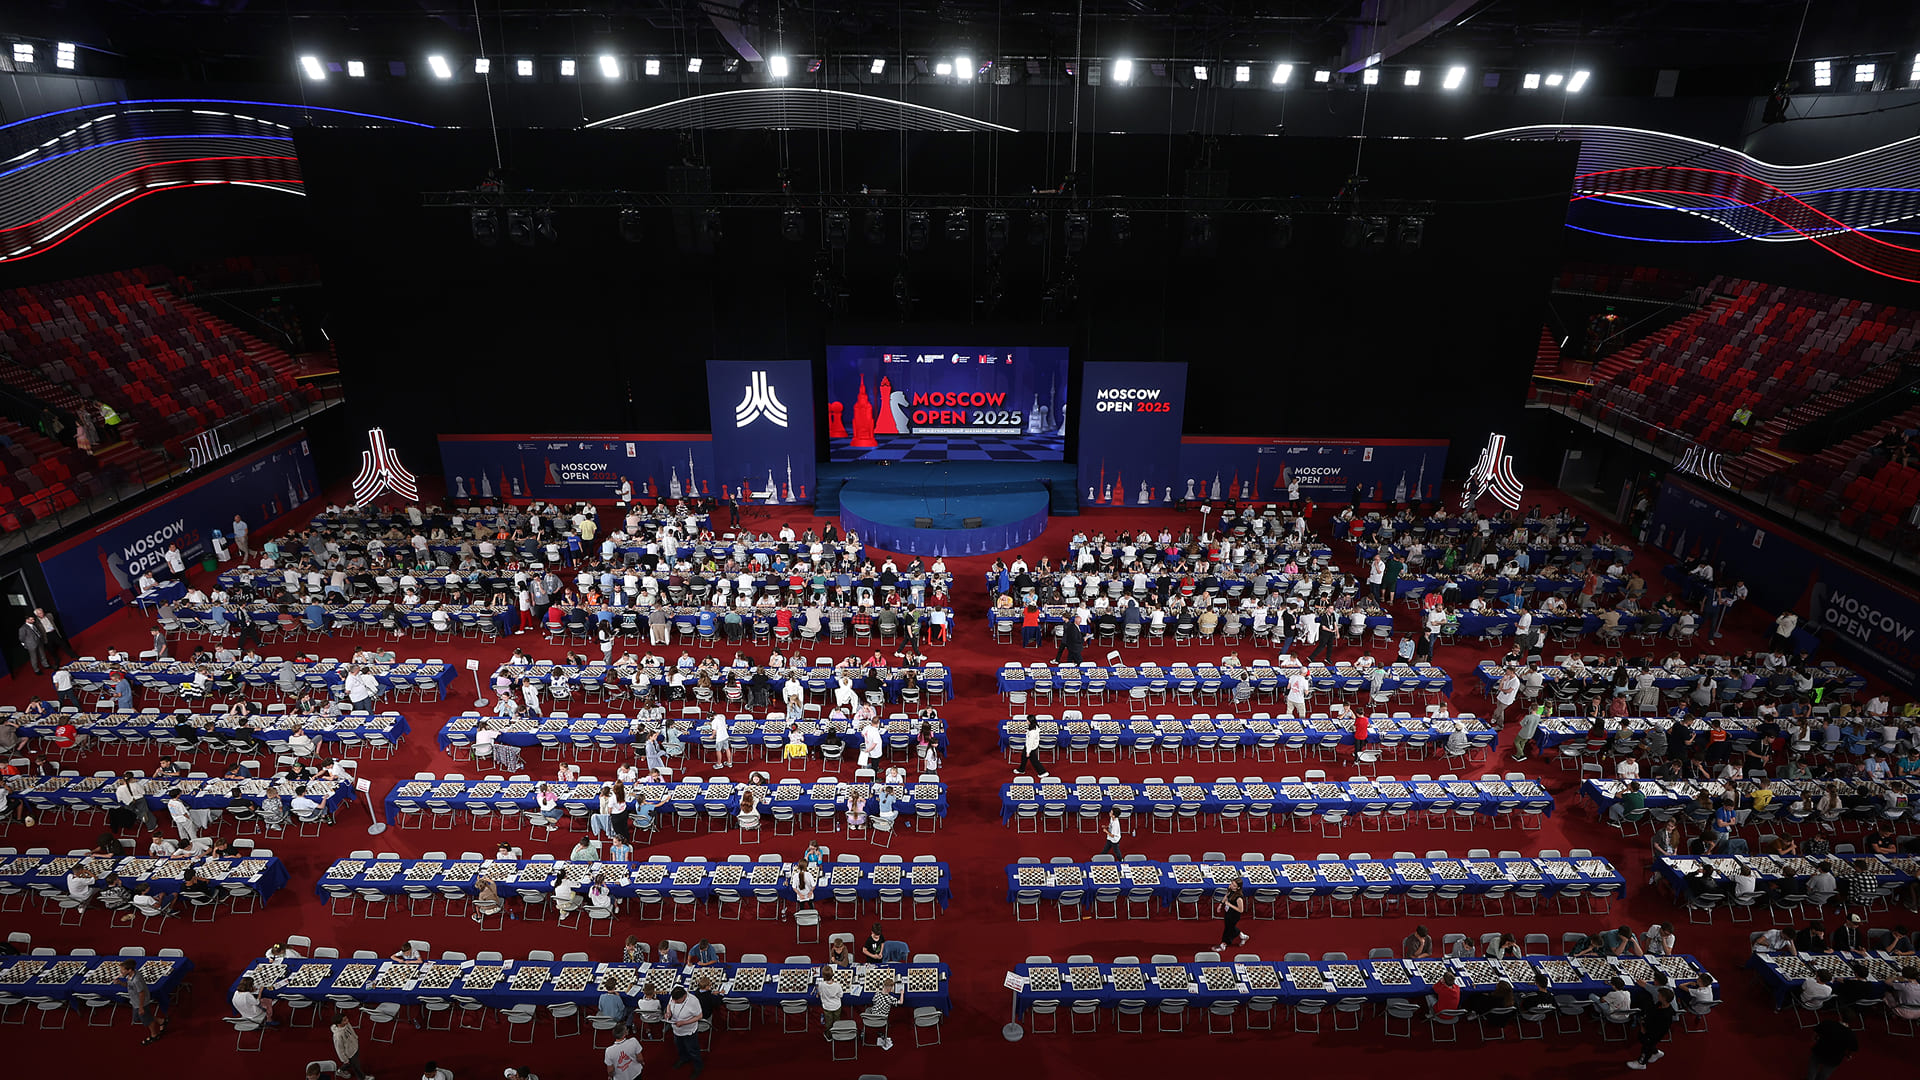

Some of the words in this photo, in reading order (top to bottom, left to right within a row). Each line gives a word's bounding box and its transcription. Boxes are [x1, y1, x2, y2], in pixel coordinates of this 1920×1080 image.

[912, 392, 1006, 406] MOSCOW
[1097, 388, 1161, 400] MOSCOW
[1096, 401, 1133, 412] OPEN
[1136, 402, 1171, 412] 2025
[912, 410, 966, 424] OPEN
[972, 410, 1022, 425] 2025
[561, 463, 607, 471] MOSCOW
[1294, 467, 1341, 475] MOSCOW
[562, 472, 589, 480] OPEN
[592, 472, 618, 480] 2025
[124, 519, 184, 561] MOSCOW
[129, 547, 166, 576] OPEN
[1830, 590, 1915, 642] MOSCOW
[1825, 608, 1872, 643] OPEN
